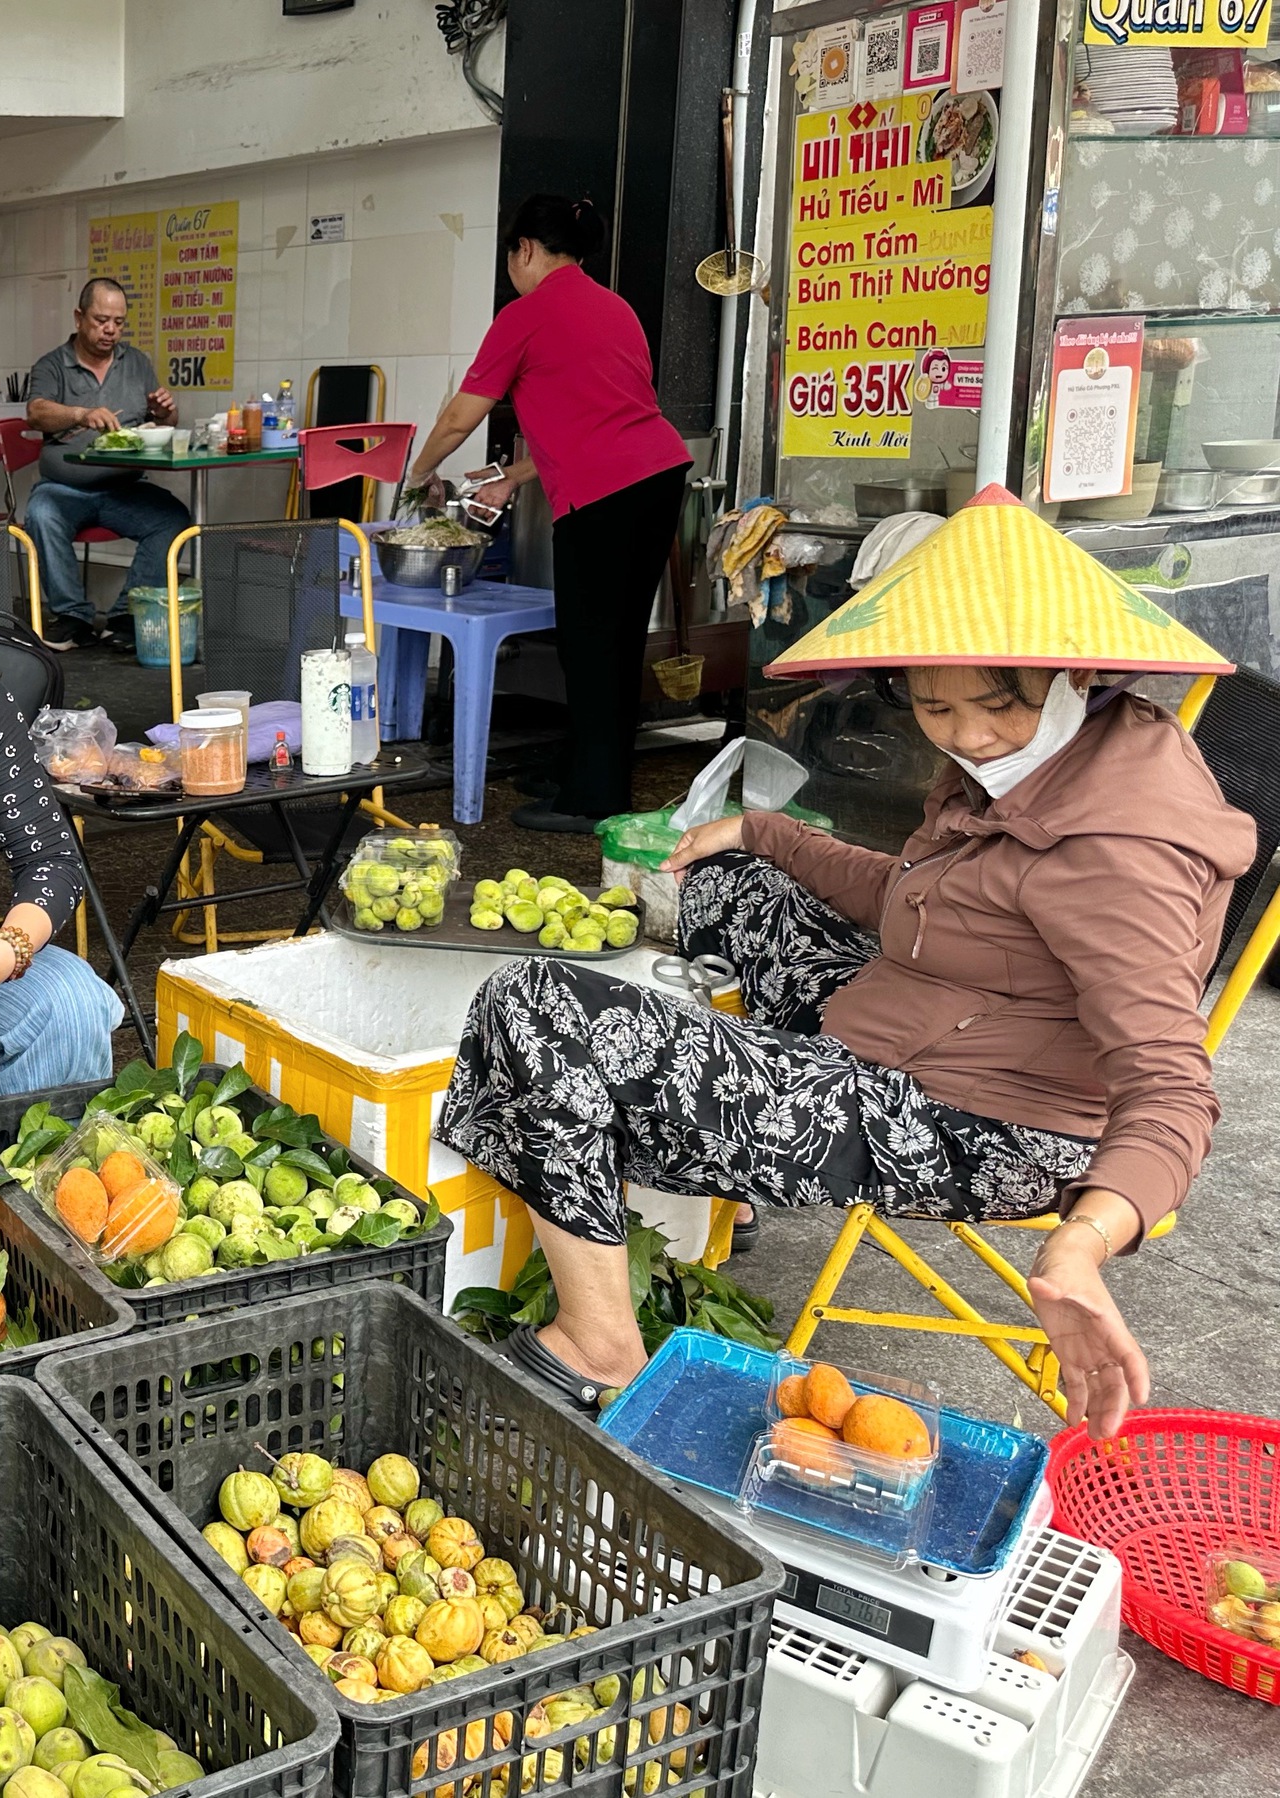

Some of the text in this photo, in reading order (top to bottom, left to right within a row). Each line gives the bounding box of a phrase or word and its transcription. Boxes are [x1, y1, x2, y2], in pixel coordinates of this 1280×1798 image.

[799, 188, 830, 222] Hủ
[839, 179, 888, 216] Tiếu
[912, 173, 944, 207] Mì
[193, 209, 211, 230] 67
[178, 242, 218, 263] CƠM TẤM
[797, 221, 918, 268] Cơm Tấm
[798, 259, 990, 304] Bún Thịt Nướng
[186, 315, 210, 330] CANH
[798, 322, 857, 351] Bánh
[866, 319, 937, 348] Canh
[168, 356, 206, 387] 35K
[788, 362, 914, 415] Giá 35K
[832, 1583, 881, 1606] TOTAL PRICE
